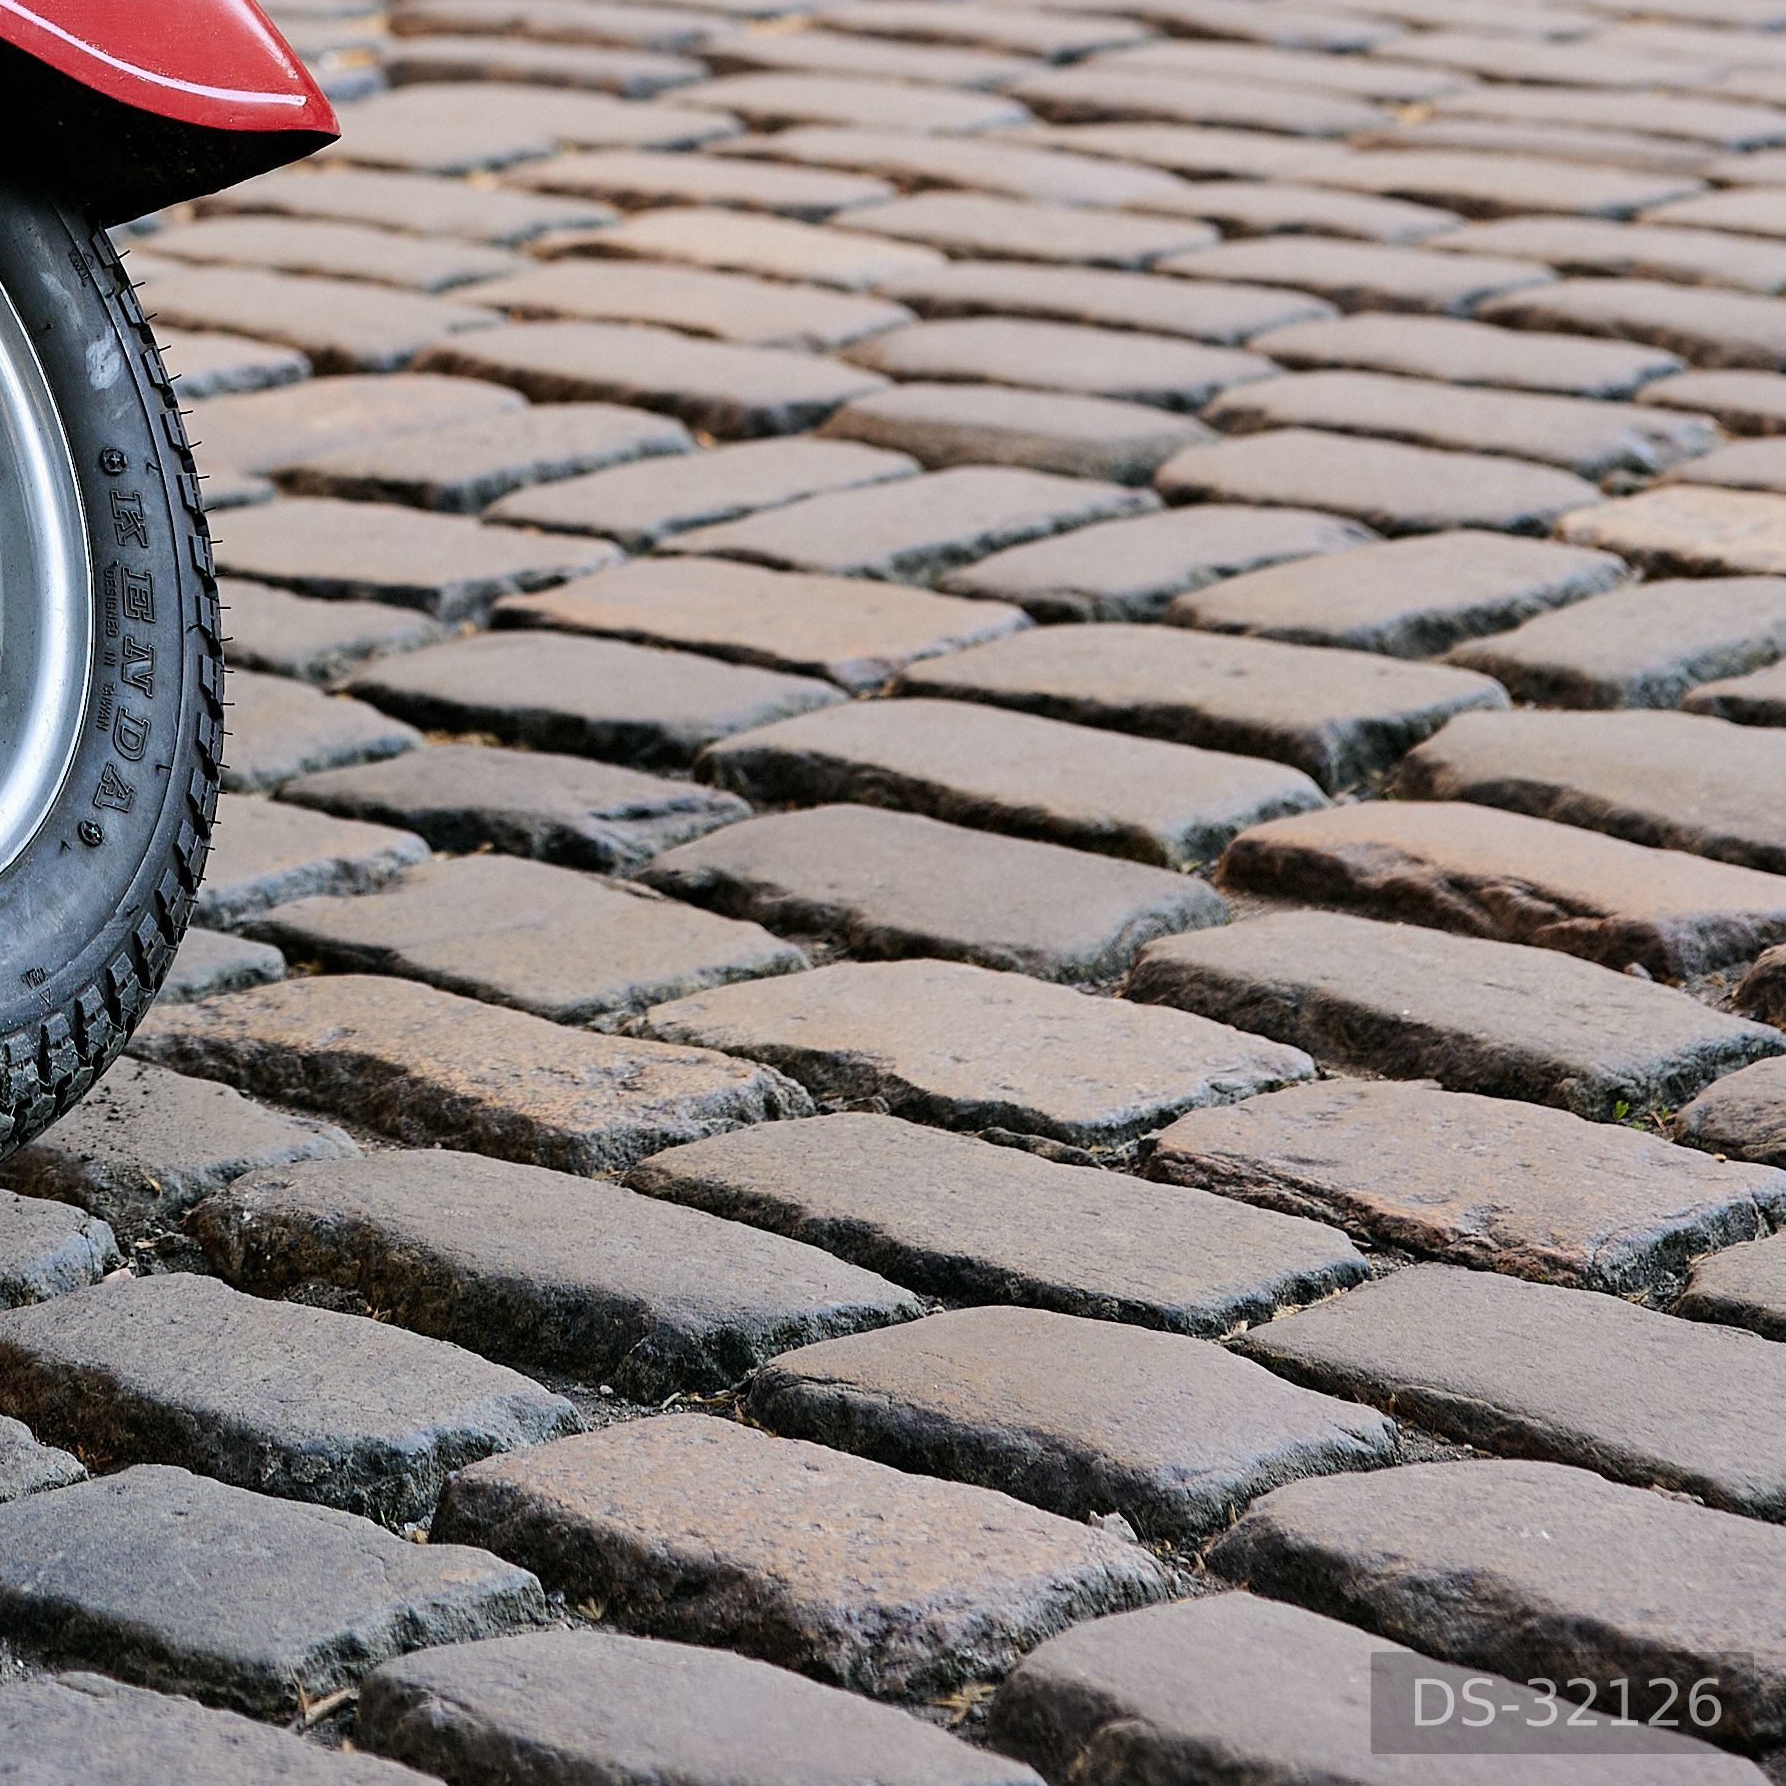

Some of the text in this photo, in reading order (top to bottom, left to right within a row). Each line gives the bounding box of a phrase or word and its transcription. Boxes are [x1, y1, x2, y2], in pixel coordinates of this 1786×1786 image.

[95, 488, 156, 814] KENDA
[96, 567, 119, 731] DESIGNED IN TAIWAN
